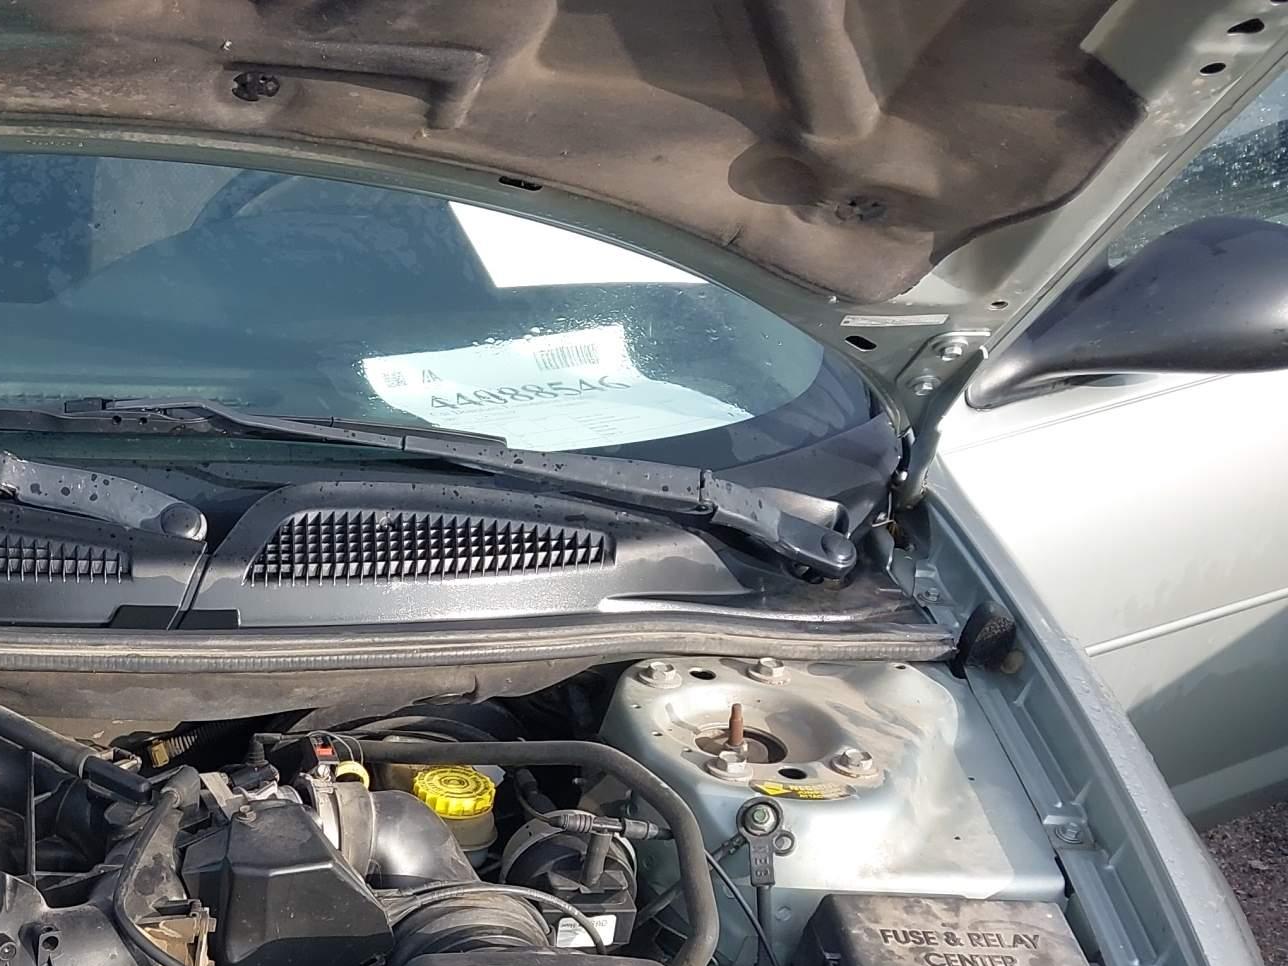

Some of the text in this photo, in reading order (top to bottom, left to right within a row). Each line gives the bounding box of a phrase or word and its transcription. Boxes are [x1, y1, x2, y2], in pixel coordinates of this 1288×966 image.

[431, 375, 632, 409] 44088546
[879, 928, 1040, 950] FUSE & RELAY
